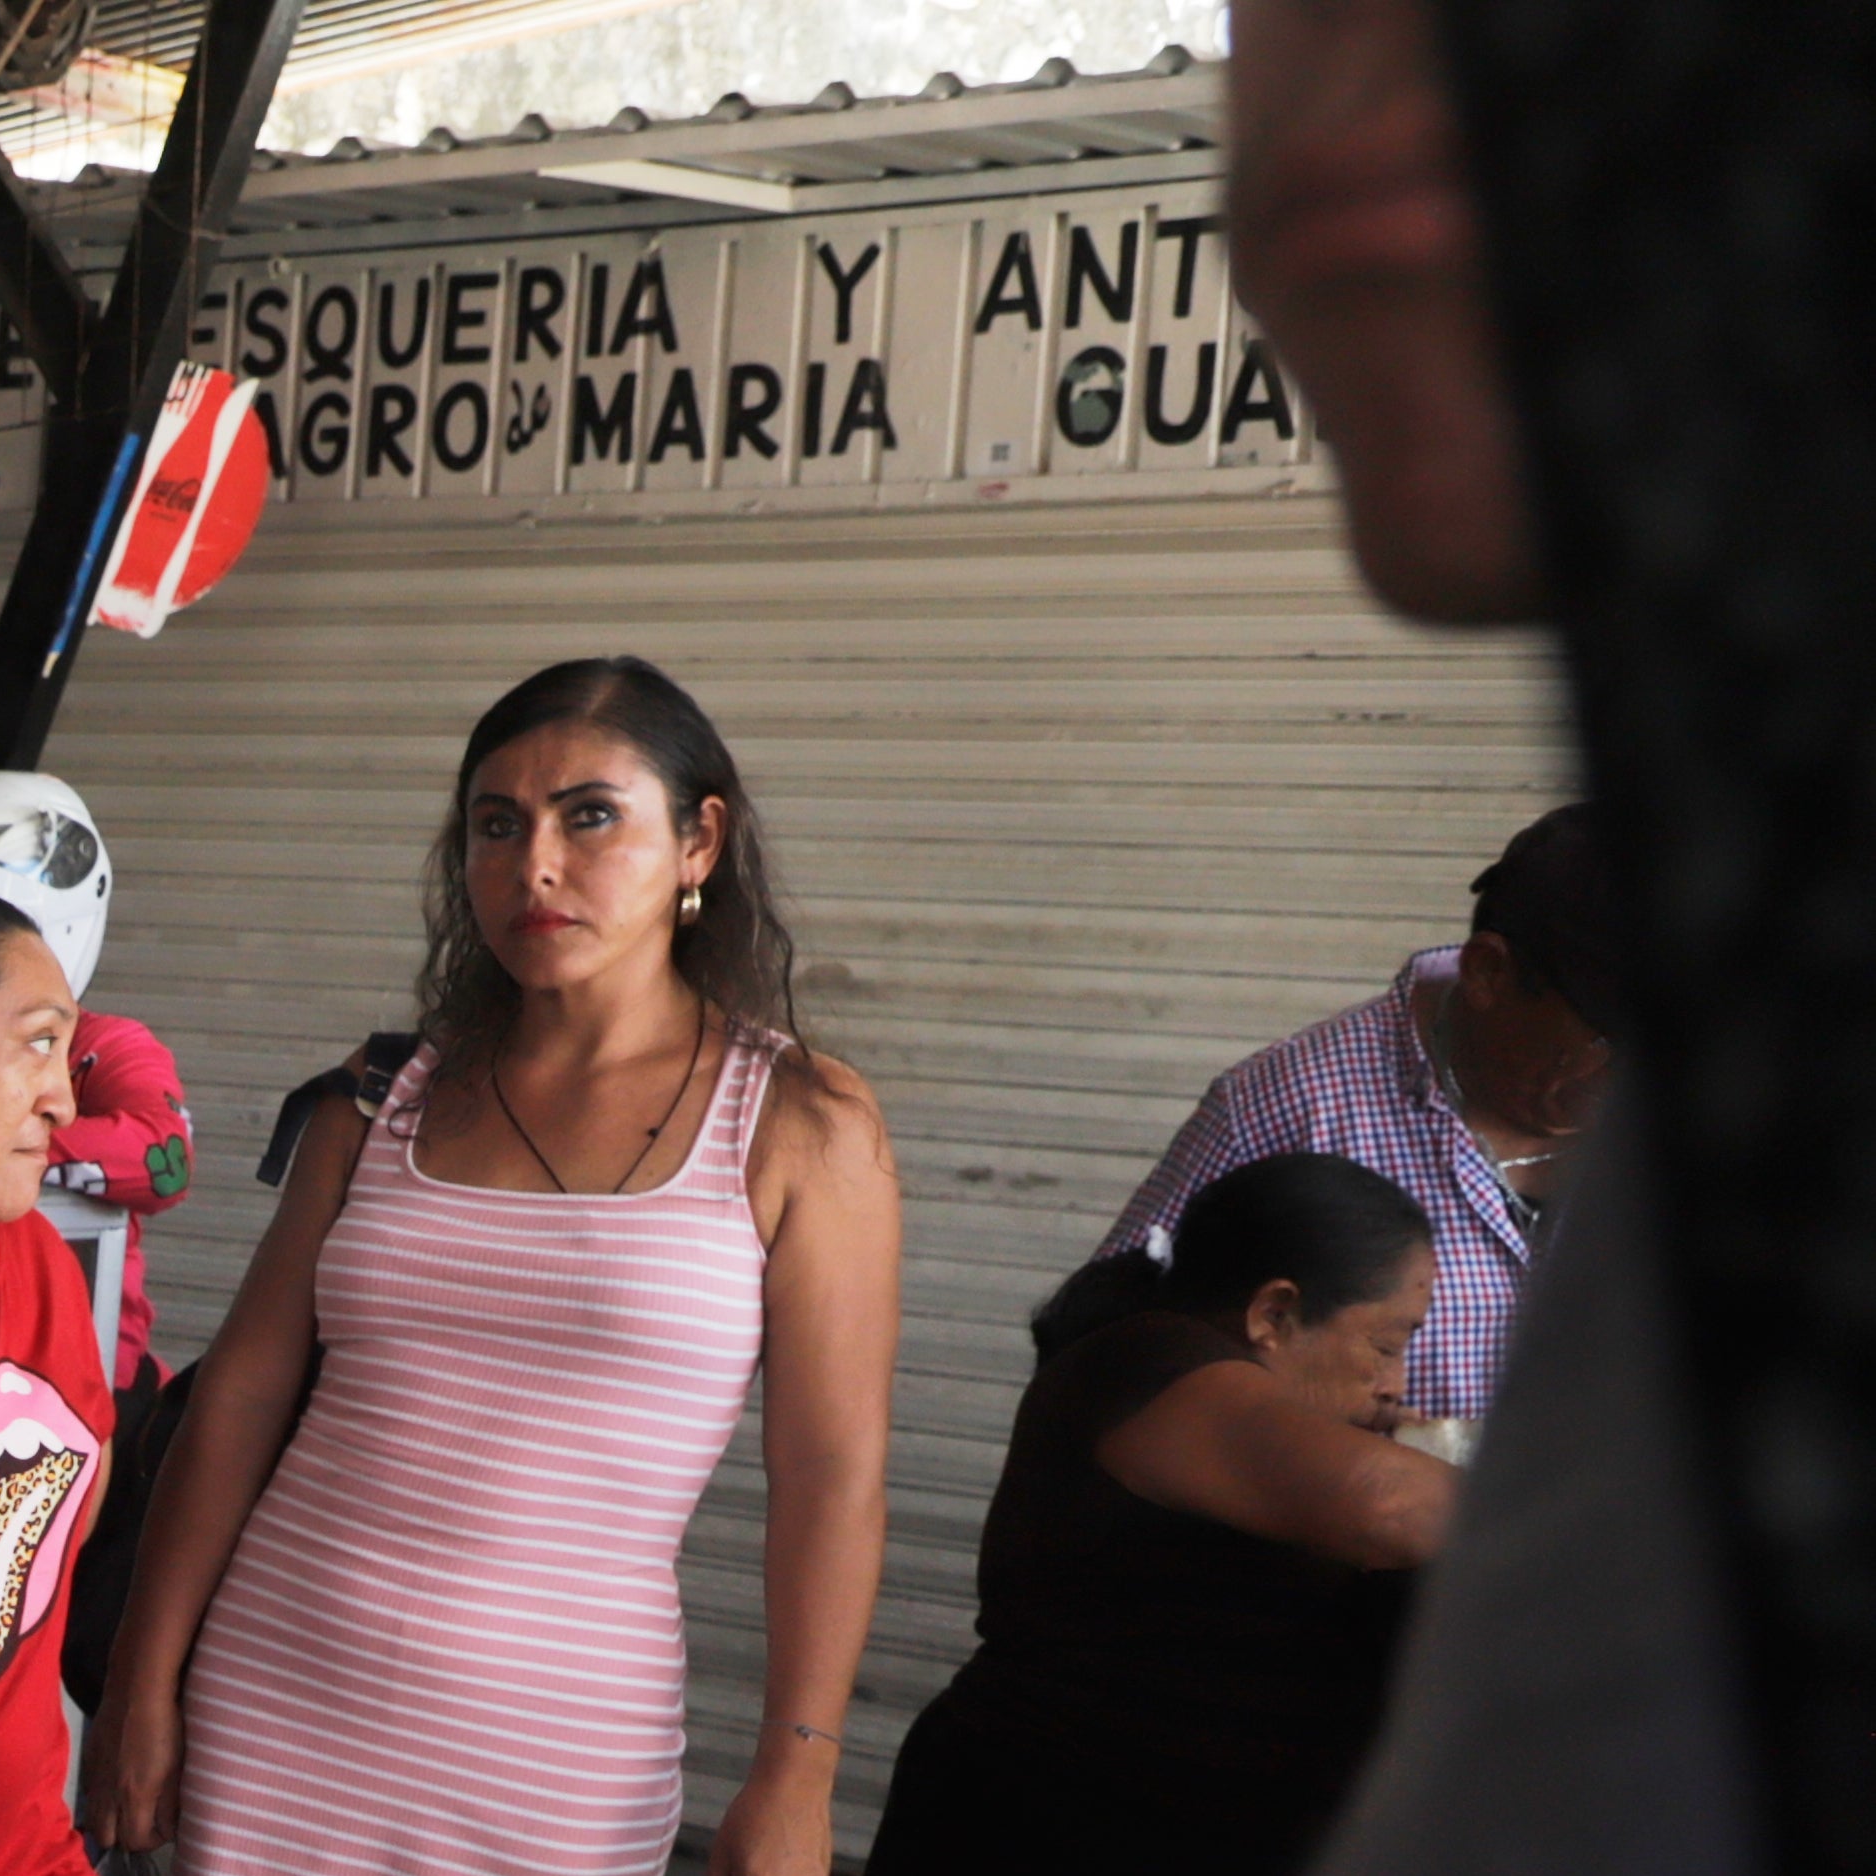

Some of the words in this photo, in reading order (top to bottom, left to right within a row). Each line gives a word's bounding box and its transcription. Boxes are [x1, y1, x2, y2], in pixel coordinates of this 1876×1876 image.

[818, 243, 880, 344] Y
[572, 358, 898, 466] MARIA
[1056, 338, 1328, 447] GUA
